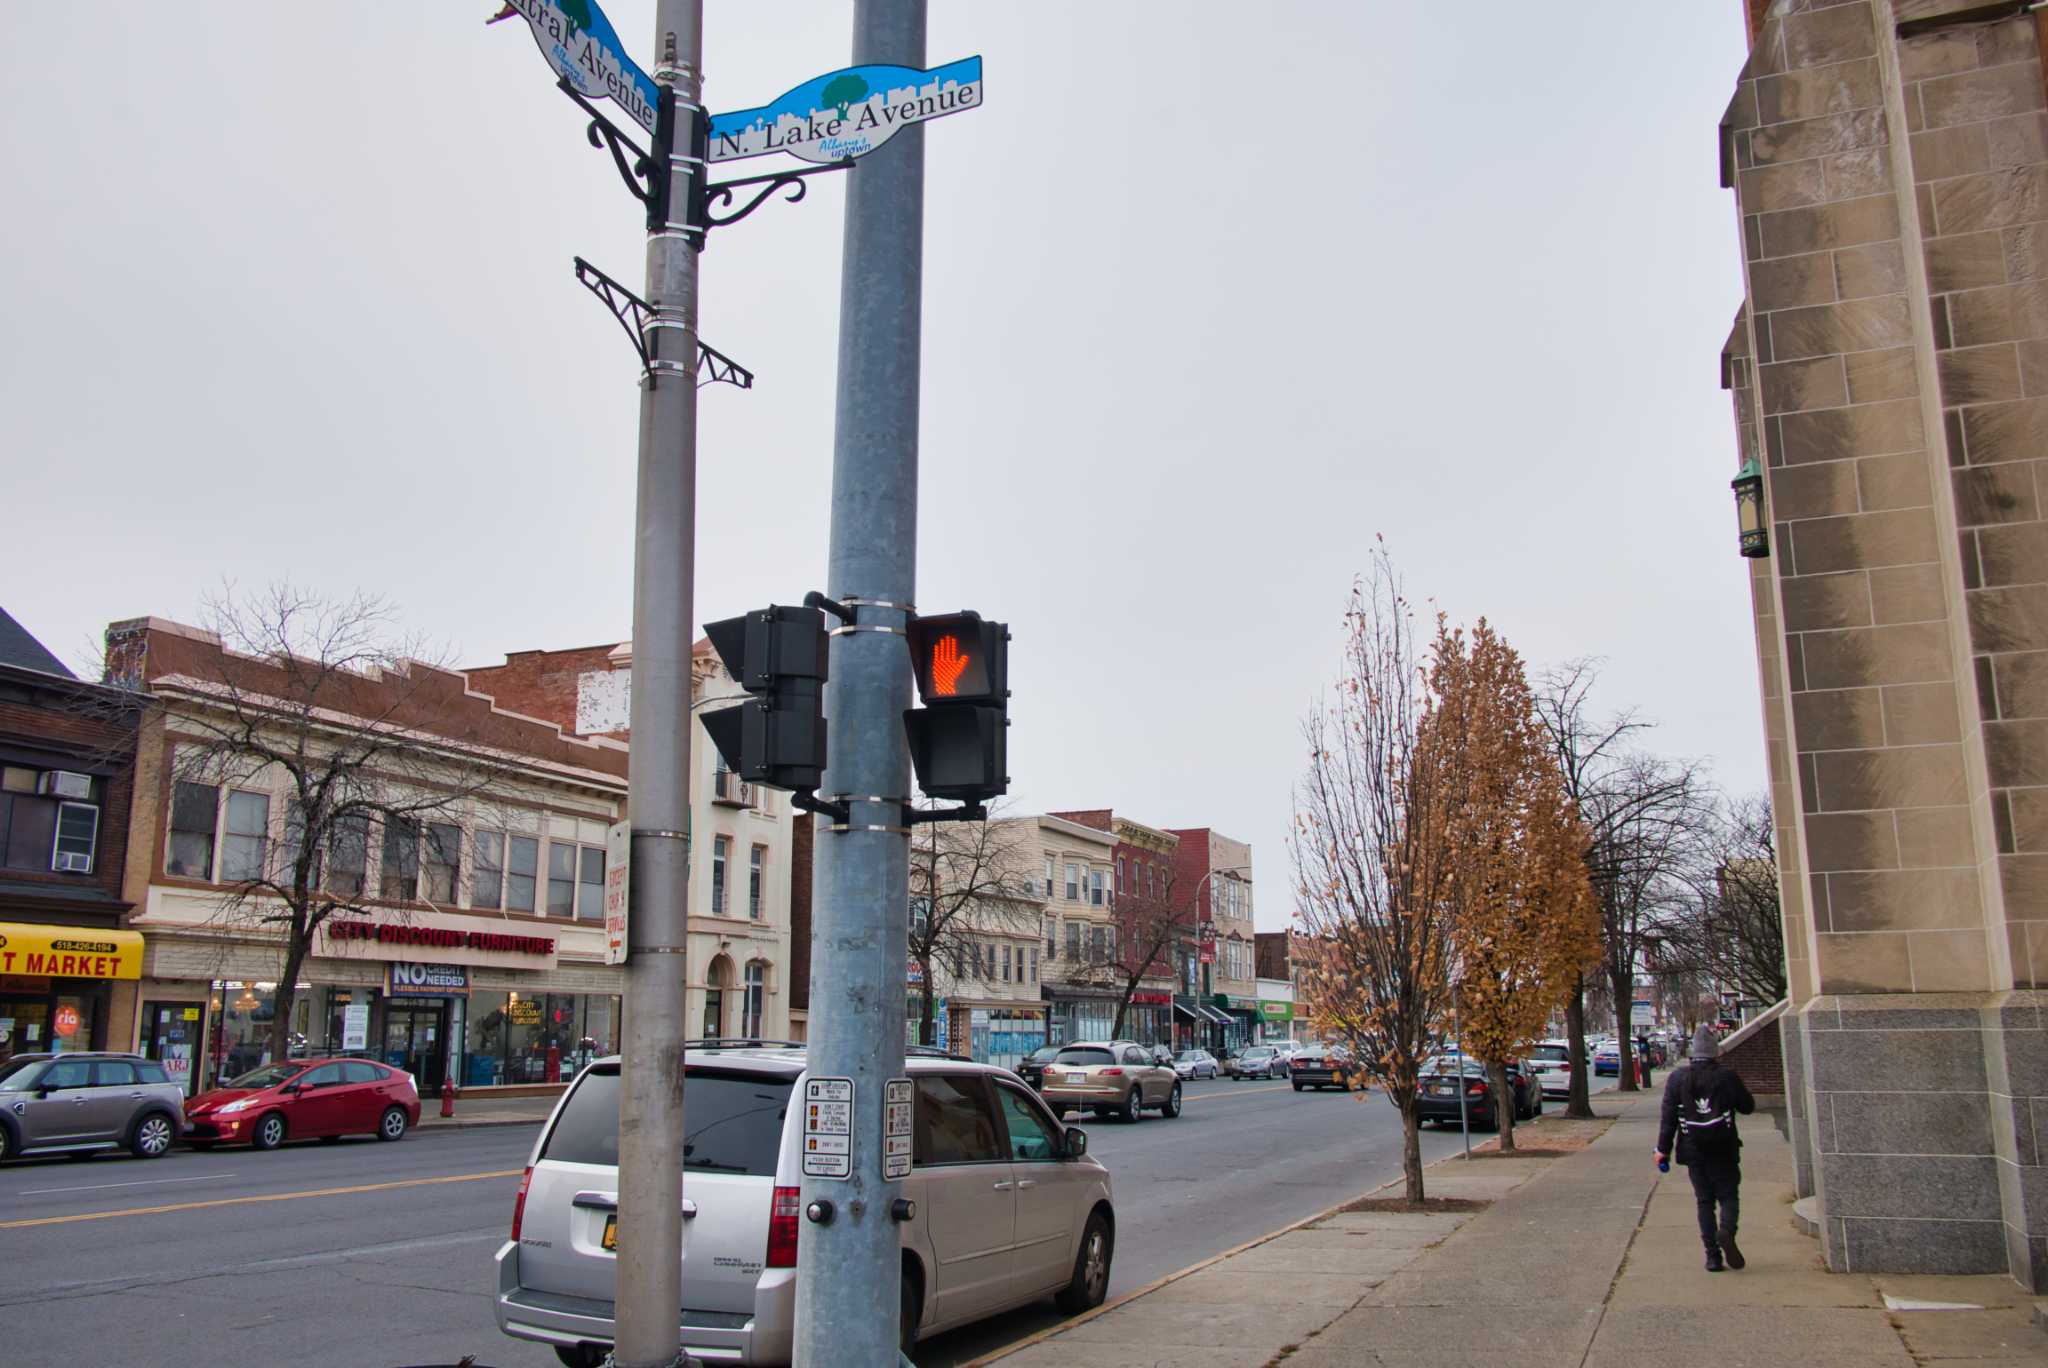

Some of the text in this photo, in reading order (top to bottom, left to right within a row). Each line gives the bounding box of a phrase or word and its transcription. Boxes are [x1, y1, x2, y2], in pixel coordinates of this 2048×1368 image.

[579, 41, 653, 126] Avenue
[716, 86, 974, 156] N. Lake Avenue
[831, 144, 871, 159] uptown
[329, 921, 555, 954] CITY DISCOUNT FURNITURE
[26, 953, 122, 976] MARKET
[394, 963, 427, 985] NO
[426, 975, 464, 985] NEEDED
